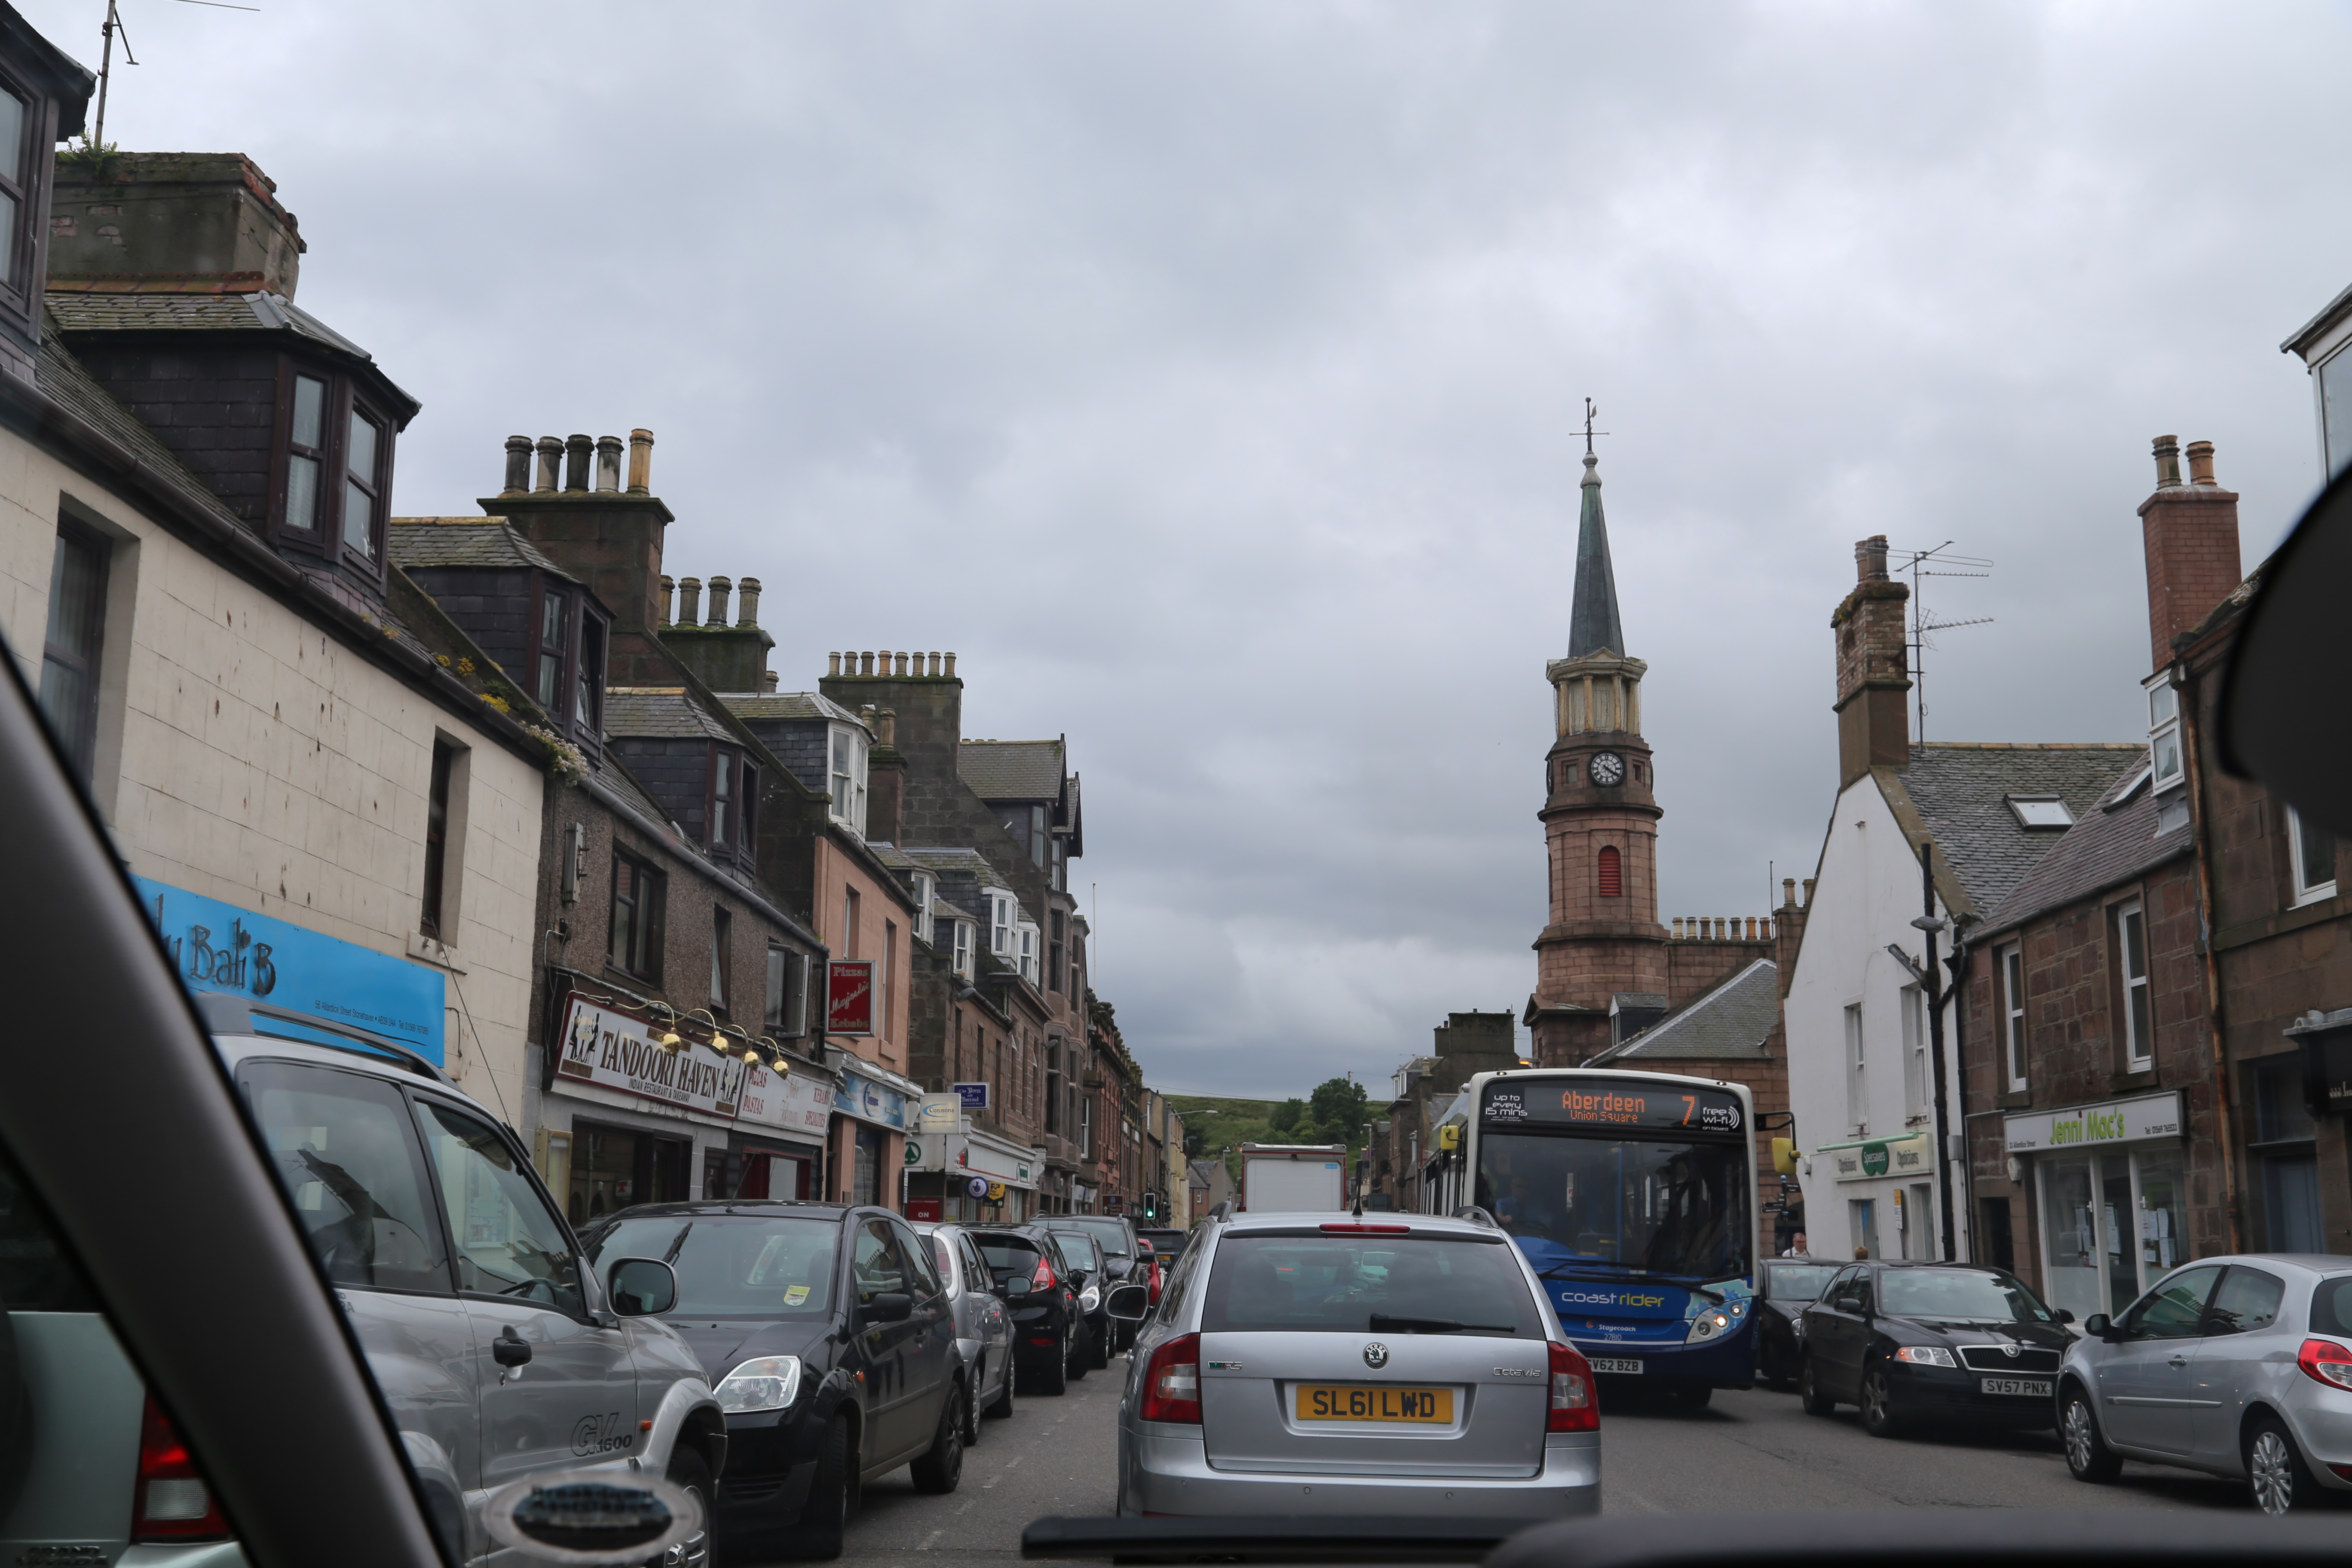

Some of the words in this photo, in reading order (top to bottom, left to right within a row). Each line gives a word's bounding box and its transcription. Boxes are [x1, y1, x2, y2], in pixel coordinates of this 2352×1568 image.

[191, 917, 251, 989] Bali
[833, 967, 868, 976] Pizzas
[830, 981, 870, 1014] Majestic
[315, 1000, 321, 1009] 56
[322, 1001, 339, 1014] Allardice
[340, 1005, 352, 1017] Street
[352, 1009, 374, 1022] Stonehaven
[378, 1015, 388, 1026] AB39
[830, 1018, 868, 1028] Kebabs
[600, 1028, 677, 1087] TANDOORI
[677, 1056, 720, 1099] HAVEN
[748, 1069, 767, 1088] PIZZAS
[628, 1078, 644, 1091] INDIAN
[644, 1082, 668, 1097] RESTAURANT
[669, 1089, 672, 1098] &
[673, 1090, 691, 1103] TAKEAWAY
[813, 1088, 830, 1105] KEBABS
[743, 1095, 764, 1115] PASTAS
[1562, 1090, 1645, 1112] Aberdeen
[1682, 1096, 1695, 1125] 7
[1703, 1107, 1727, 1115] free
[805, 1110, 826, 1128] SPECIALITIES
[1571, 1110, 1598, 1120] Union
[1600, 1111, 1638, 1123] Square
[2050, 1110, 2083, 1145] Jenni
[2087, 1106, 2125, 1141] Mac's
[2152, 1125, 2163, 1134] 01569
[2164, 1123, 2177, 1133] 765533
[1864, 1152, 1886, 1166] Specsavers
[617, 1182, 628, 1193] T
[1562, 1292, 1617, 1304] coast
[1620, 1293, 1664, 1307] rider
[1493, 1367, 1541, 1377] Octavia
[1617, 1360, 1638, 1372] BZB
[1987, 1380, 2020, 1393] SV57
[2024, 1382, 2047, 1394] PNX
[1313, 1390, 1373, 1416] SL61
[1382, 1391, 1435, 1418] LWD
[597, 1434, 632, 1452] 1600
